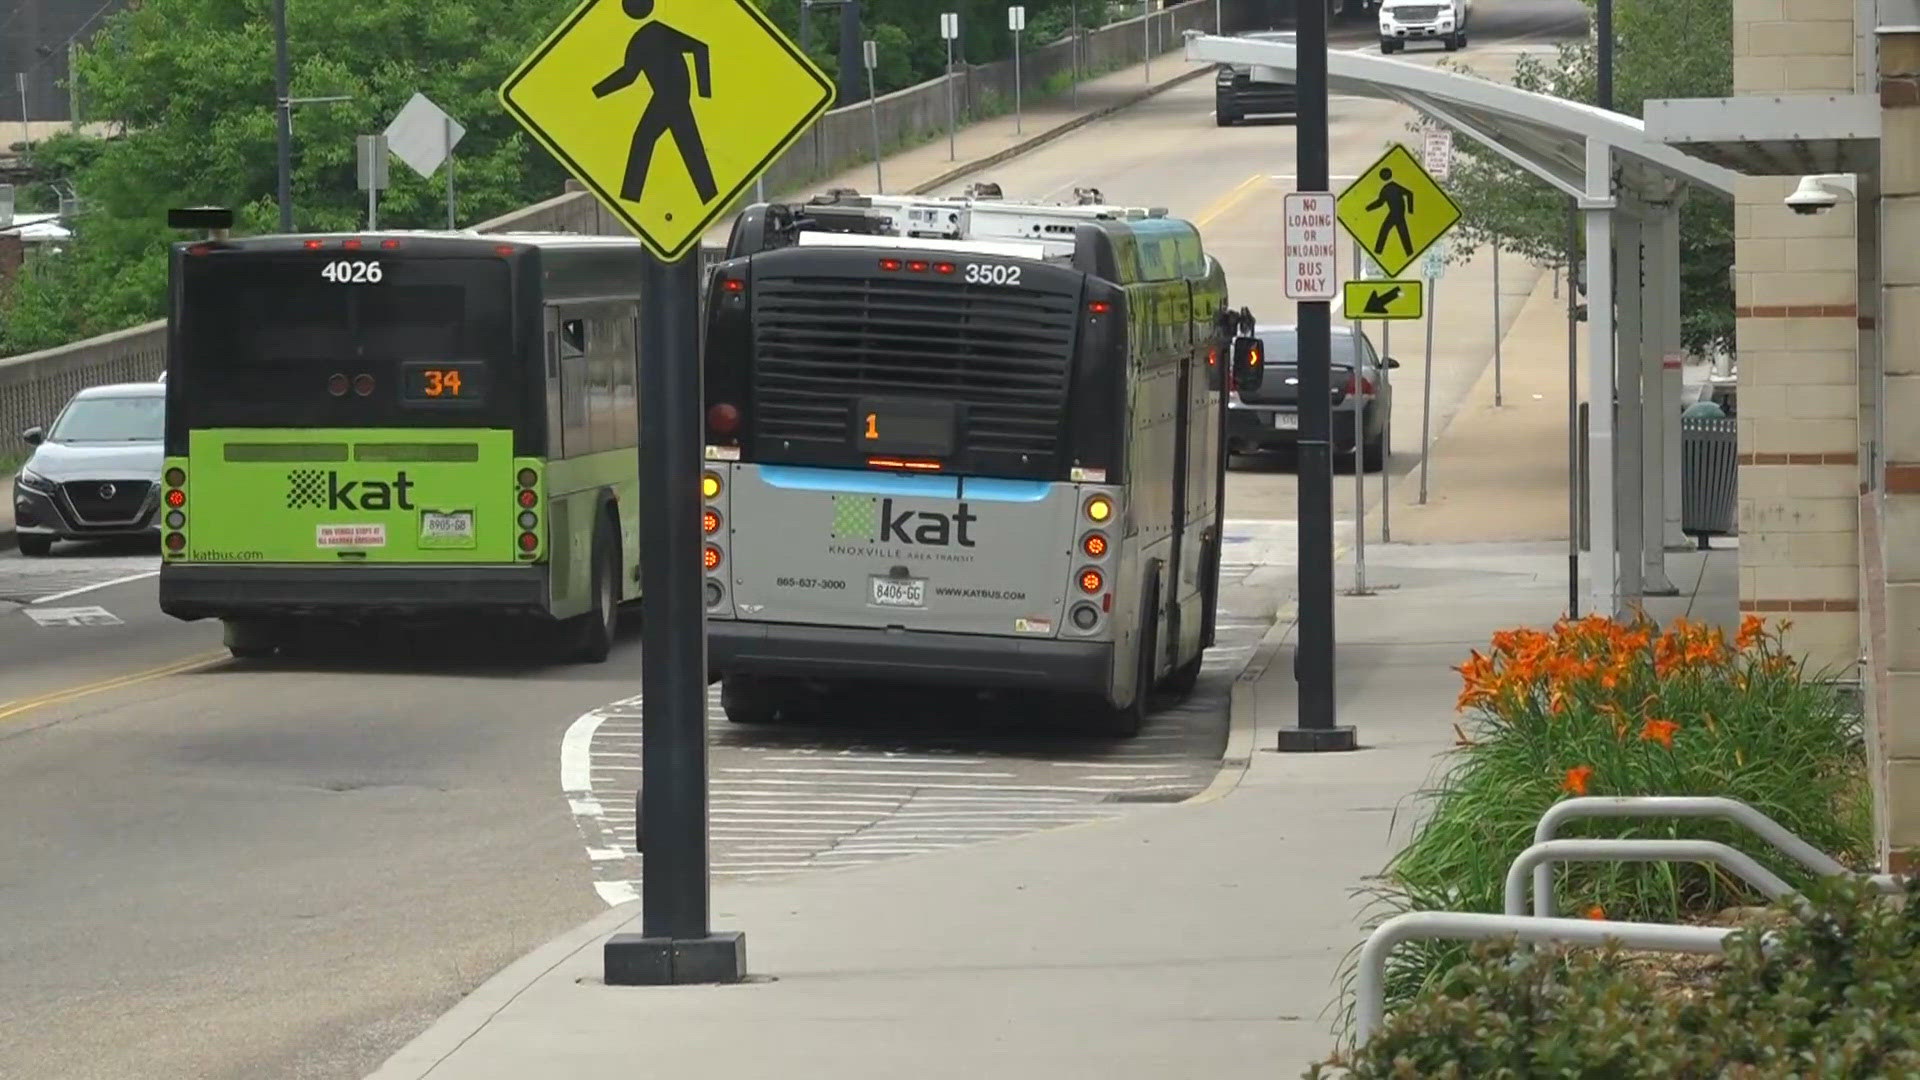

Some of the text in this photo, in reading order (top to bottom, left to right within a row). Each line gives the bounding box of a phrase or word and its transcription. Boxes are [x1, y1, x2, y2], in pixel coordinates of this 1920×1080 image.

[1303, 199, 1317, 212] NO
[1288, 216, 1331, 227] LOADING
[1303, 230, 1317, 242] OR
[1287, 245, 1334, 257] UNLOADING
[321, 260, 383, 284] 4026
[965, 263, 1021, 285] 3502
[1298, 262, 1322, 276] BUS
[1295, 279, 1325, 292] ONLY
[424, 369, 462, 397] 34
[864, 413, 879, 439] 1
[328, 471, 415, 511] kat
[880, 498, 977, 548] kat
[193, 549, 264, 562] katbus.com
[829, 546, 974, 563] KNOXVILLE AREA TRANSIT
[776, 577, 846, 590] 865-637-3000
[877, 584, 920, 600] 8406-GG
[935, 587, 1026, 600] WWW.KATBUS.COM
